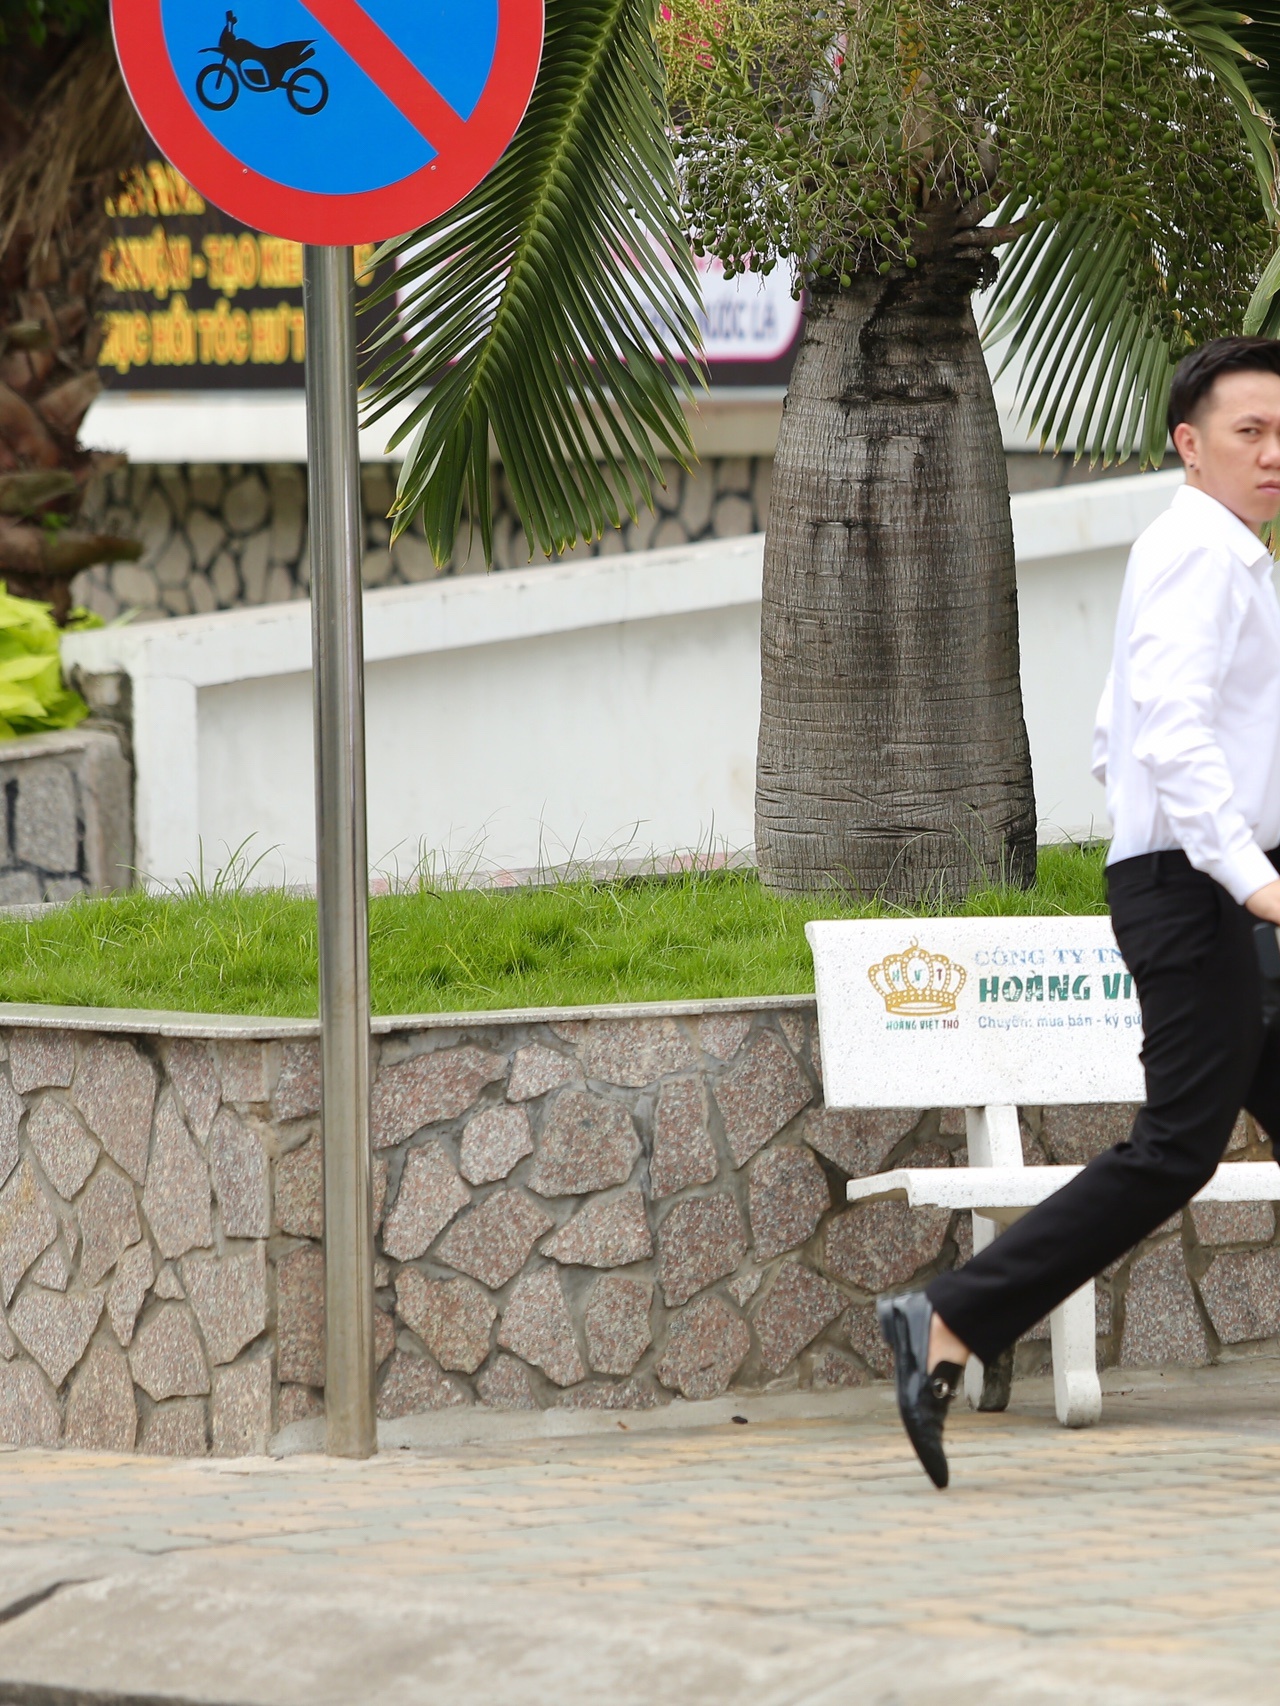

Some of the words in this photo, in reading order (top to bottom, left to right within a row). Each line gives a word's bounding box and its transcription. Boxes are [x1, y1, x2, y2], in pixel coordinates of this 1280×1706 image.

[975, 946, 1045, 966] CÔNG
[1053, 948, 1084, 965] TY
[937, 968, 943, 981] T
[1102, 973, 1139, 1000] VI
[920, 1017, 940, 1031] VIỆT
[1037, 1017, 1064, 1028] mua
[1068, 1014, 1093, 1027] bán
[1104, 1012, 1119, 1029] ký
